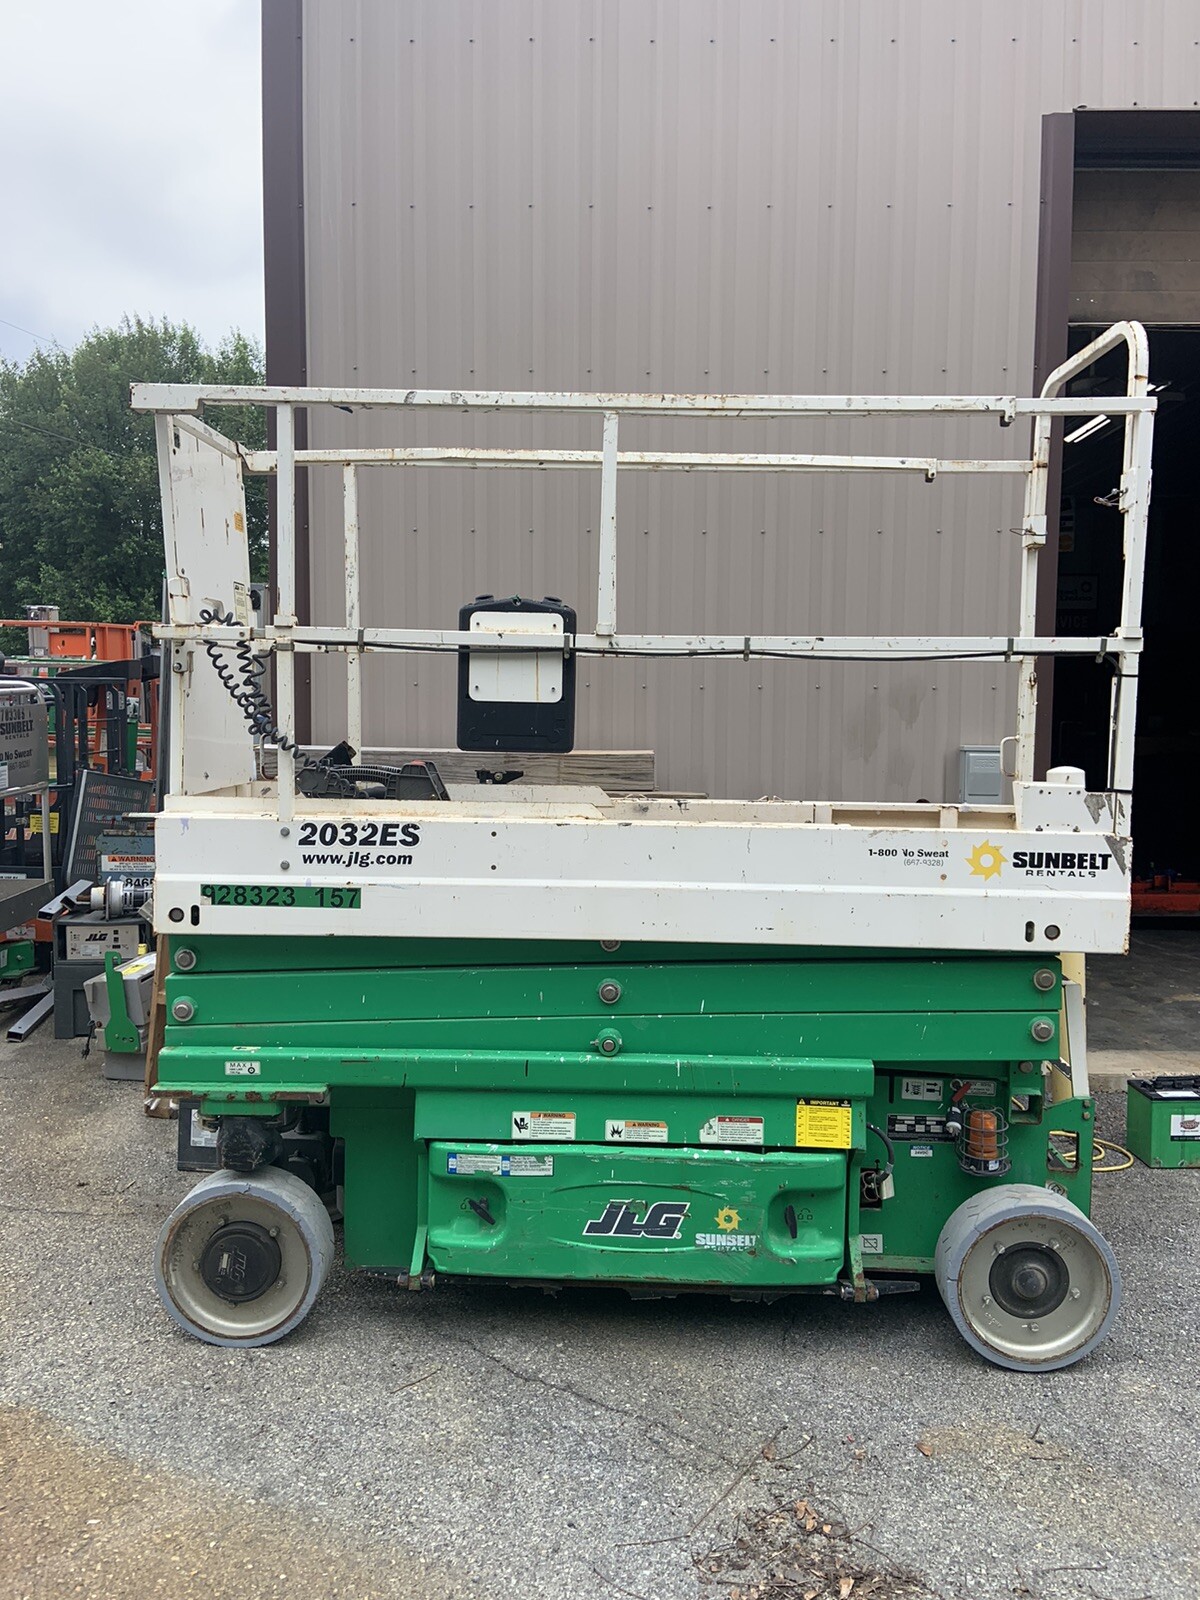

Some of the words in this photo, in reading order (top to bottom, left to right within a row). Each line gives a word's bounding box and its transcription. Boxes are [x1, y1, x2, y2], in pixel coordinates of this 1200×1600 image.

[0, 720, 34, 735] SUNBELT
[5, 750, 13, 760] No
[14, 748, 33, 759] Sweat
[298, 822, 421, 847] 2032ES
[302, 851, 413, 867] www.jlg.com
[868, 848, 898, 857] 1-800
[917, 848, 949, 858] Sweat
[1012, 851, 1112, 870] SUNBELT
[1025, 869, 1097, 878] RENTALS
[201, 884, 296, 906] 928323
[314, 887, 359, 908] 157
[85, 933, 109, 942] JLG
[582, 1198, 691, 1239] JLG
